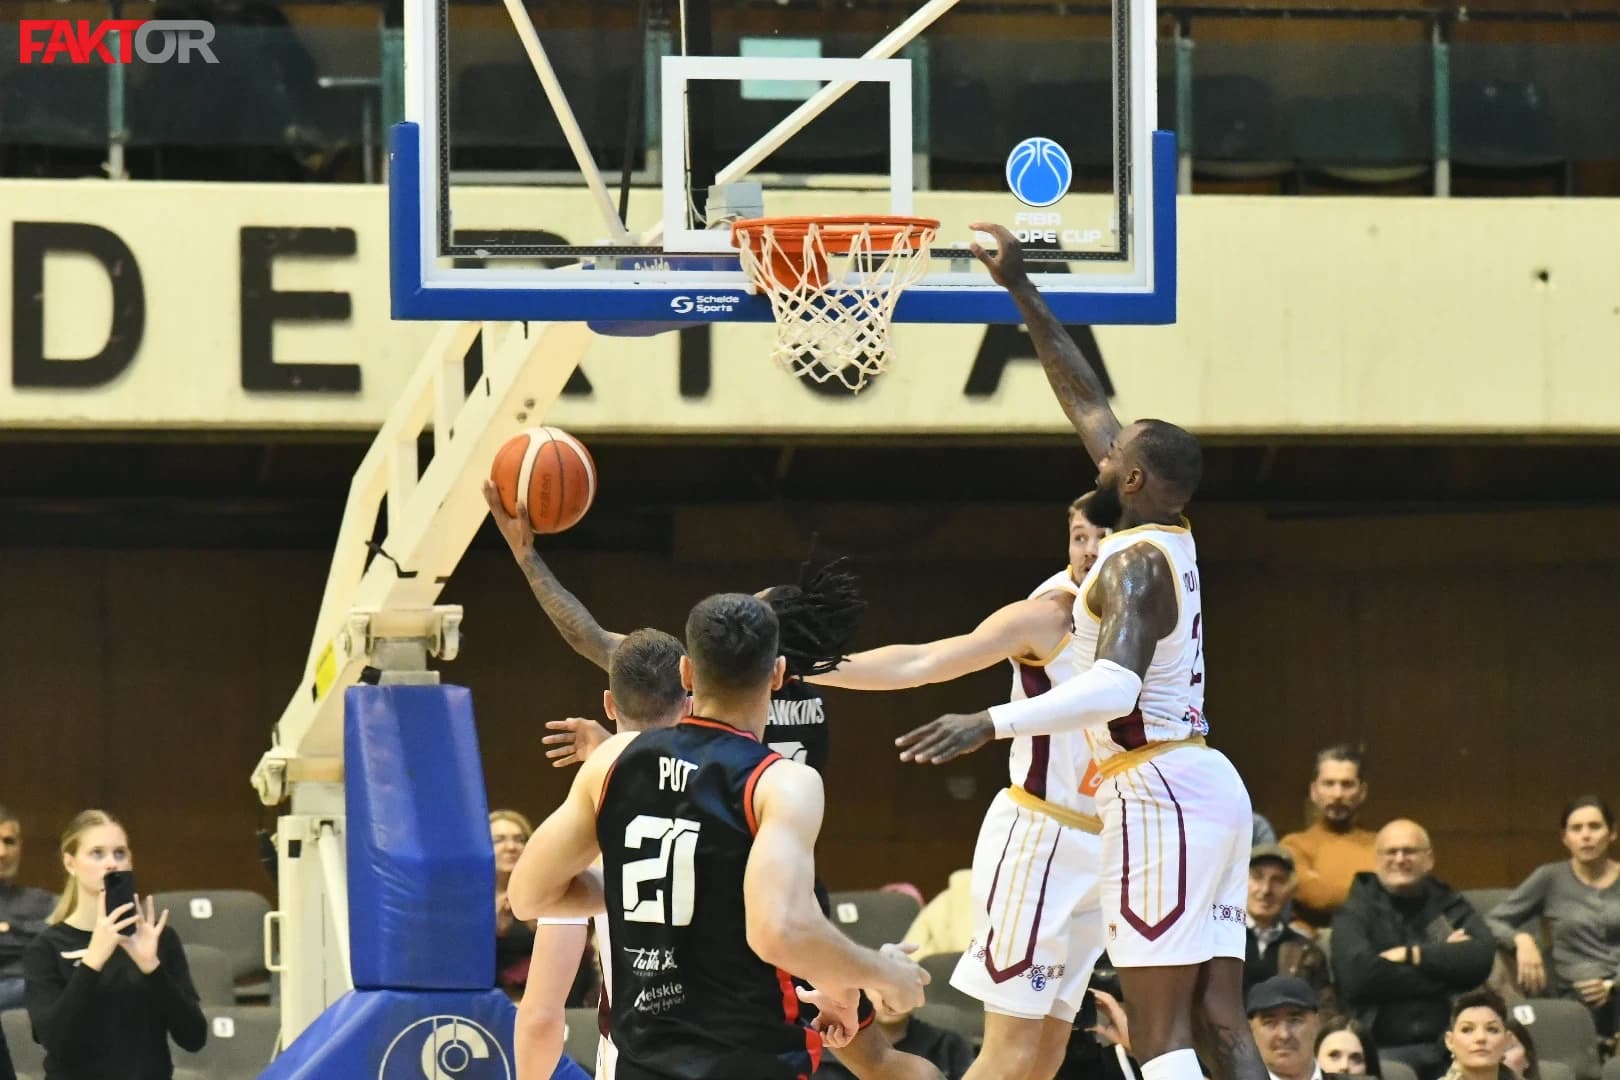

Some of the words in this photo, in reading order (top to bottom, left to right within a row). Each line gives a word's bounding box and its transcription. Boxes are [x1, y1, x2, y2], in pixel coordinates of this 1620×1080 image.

[1014, 212, 1062, 225] FIBA
[975, 229, 1056, 244] EOPE
[1061, 229, 1101, 244] CUP
[696, 295, 740, 303] Schelde
[696, 304, 734, 313] Sports
[658, 756, 699, 793] PUT
